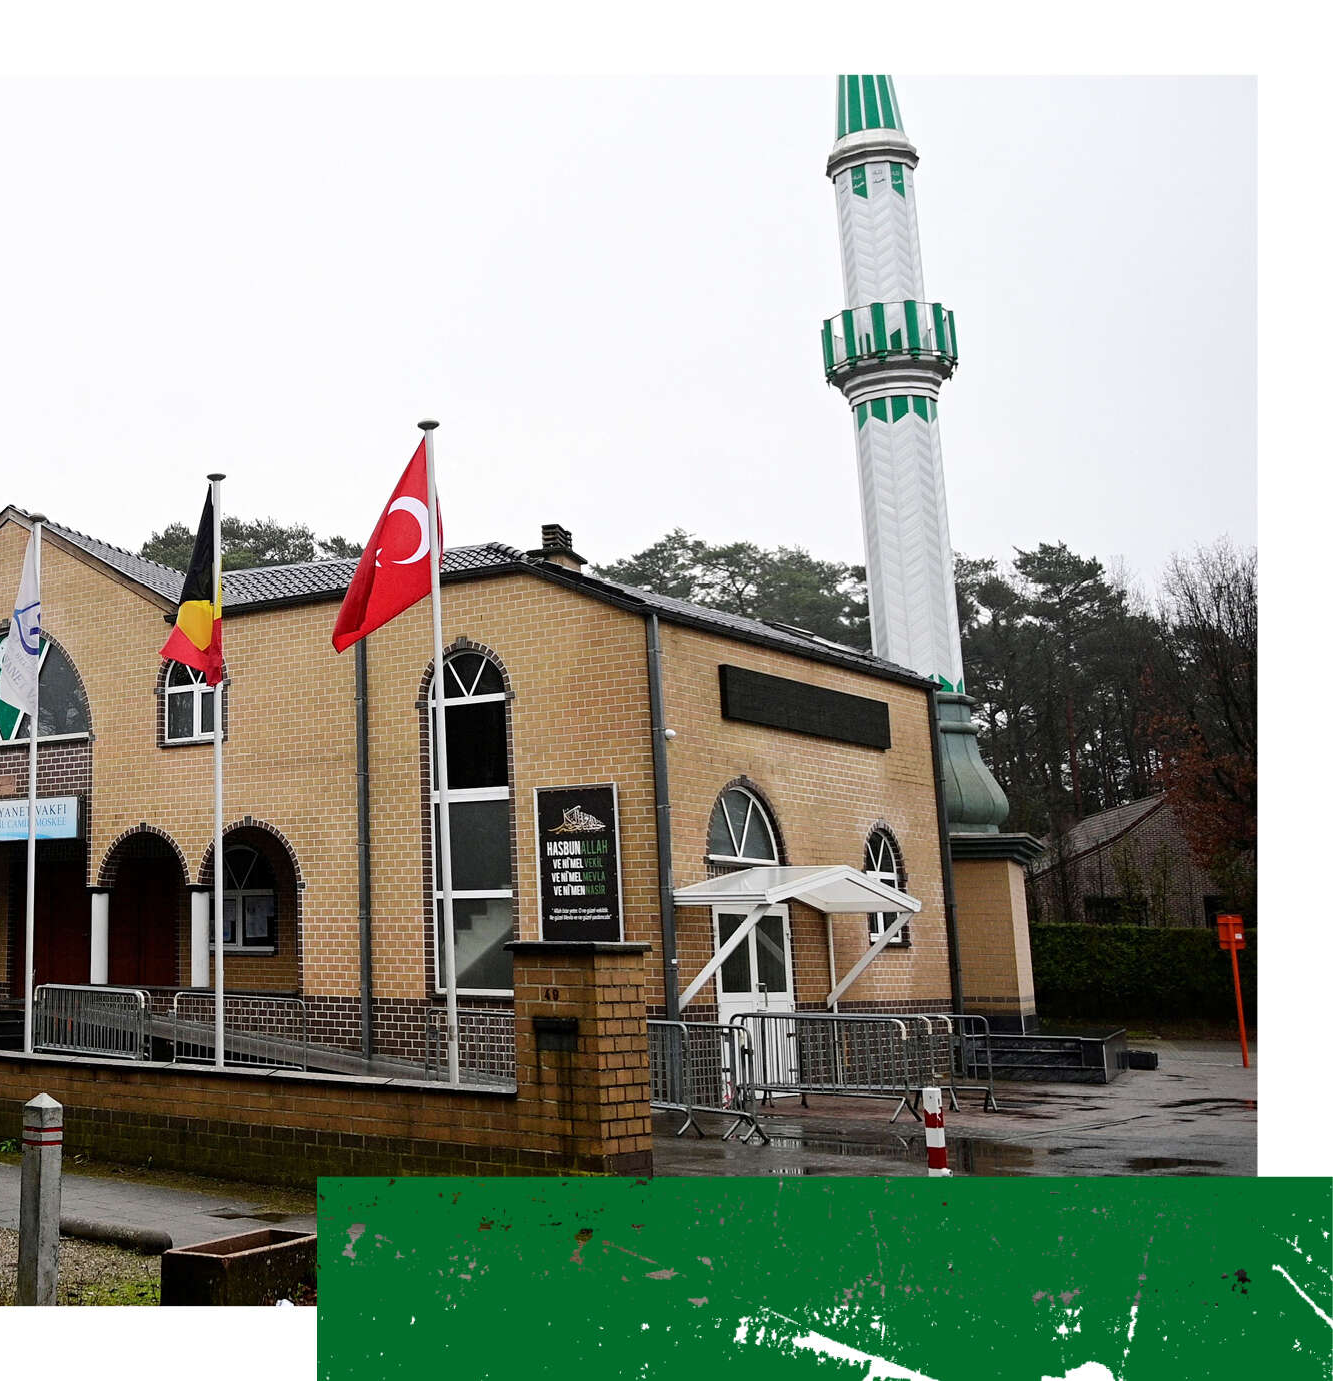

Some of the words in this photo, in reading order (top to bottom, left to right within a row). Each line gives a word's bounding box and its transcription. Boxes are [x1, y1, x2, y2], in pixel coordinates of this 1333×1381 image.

[35, 803, 67, 815] VAKFI
[552, 858, 562, 869] VE
[551, 872, 561, 883] VE
[553, 885, 563, 896] VE
